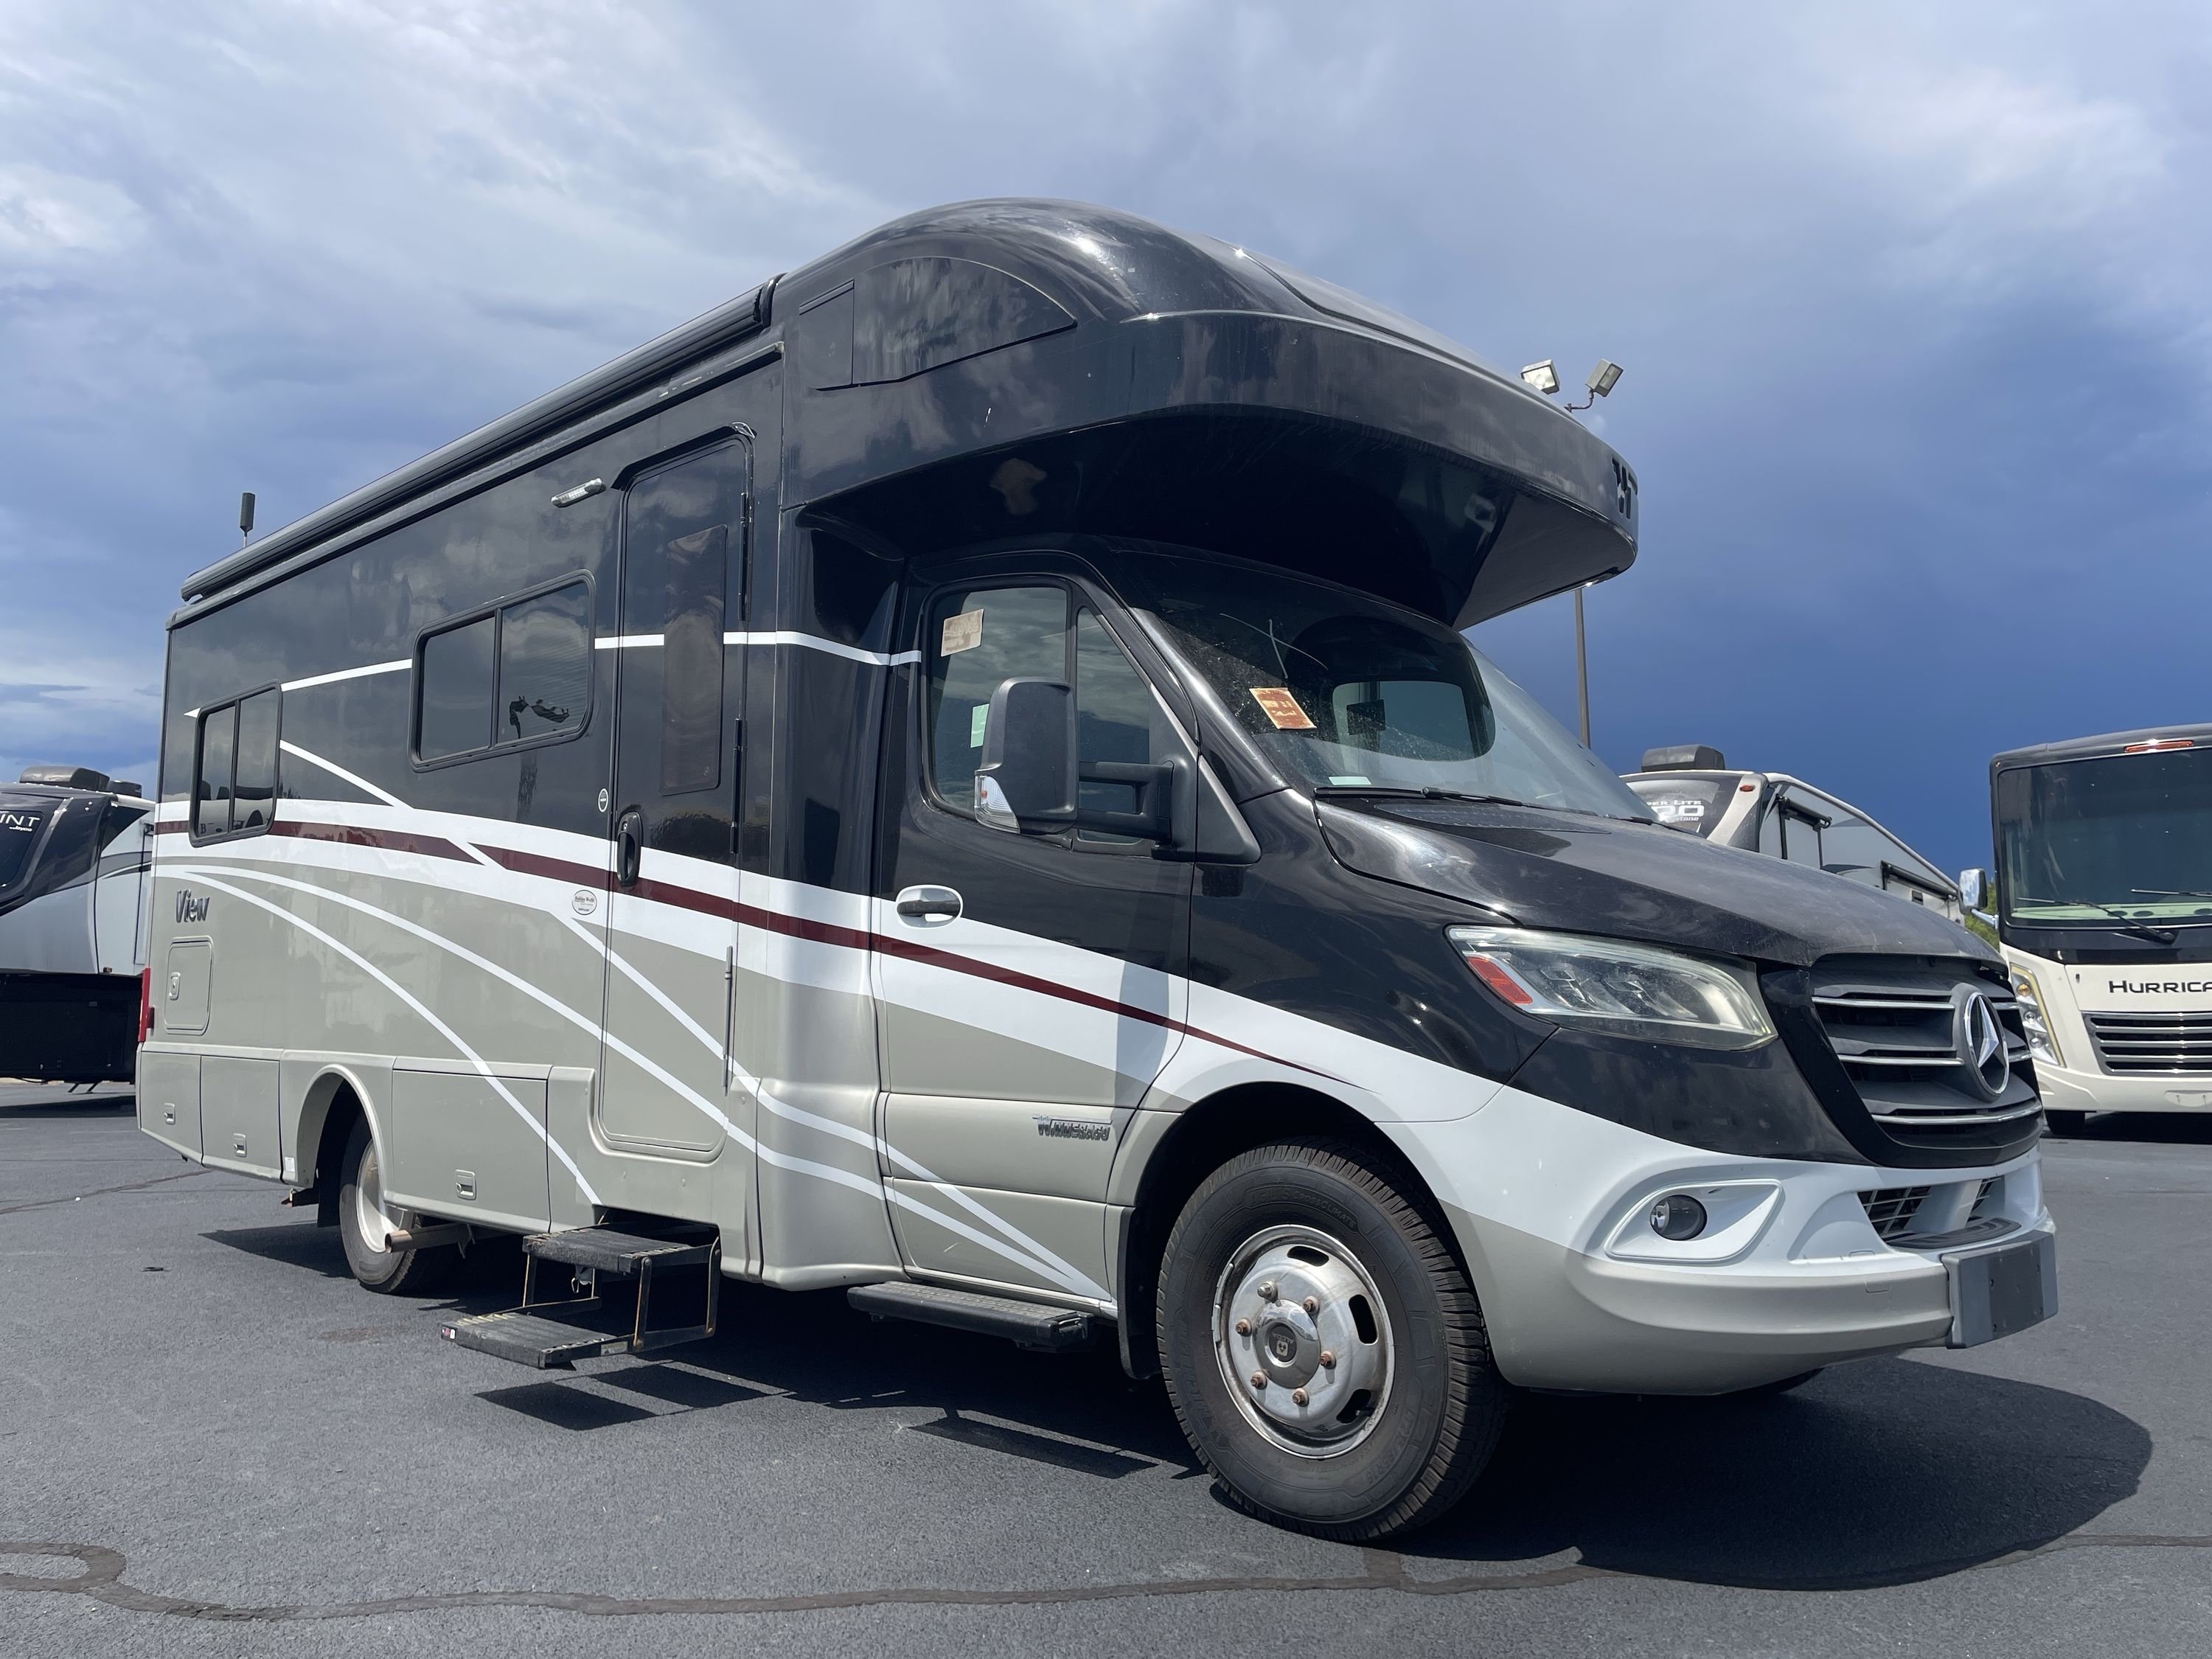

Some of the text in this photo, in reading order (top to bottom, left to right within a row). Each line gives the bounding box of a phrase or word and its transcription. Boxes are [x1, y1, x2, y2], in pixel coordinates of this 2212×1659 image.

[175, 888, 210, 923] View
[1292, 1190, 1357, 1228] CROSSCLIMATE
[1271, 1332, 1295, 1344] ALCOA
